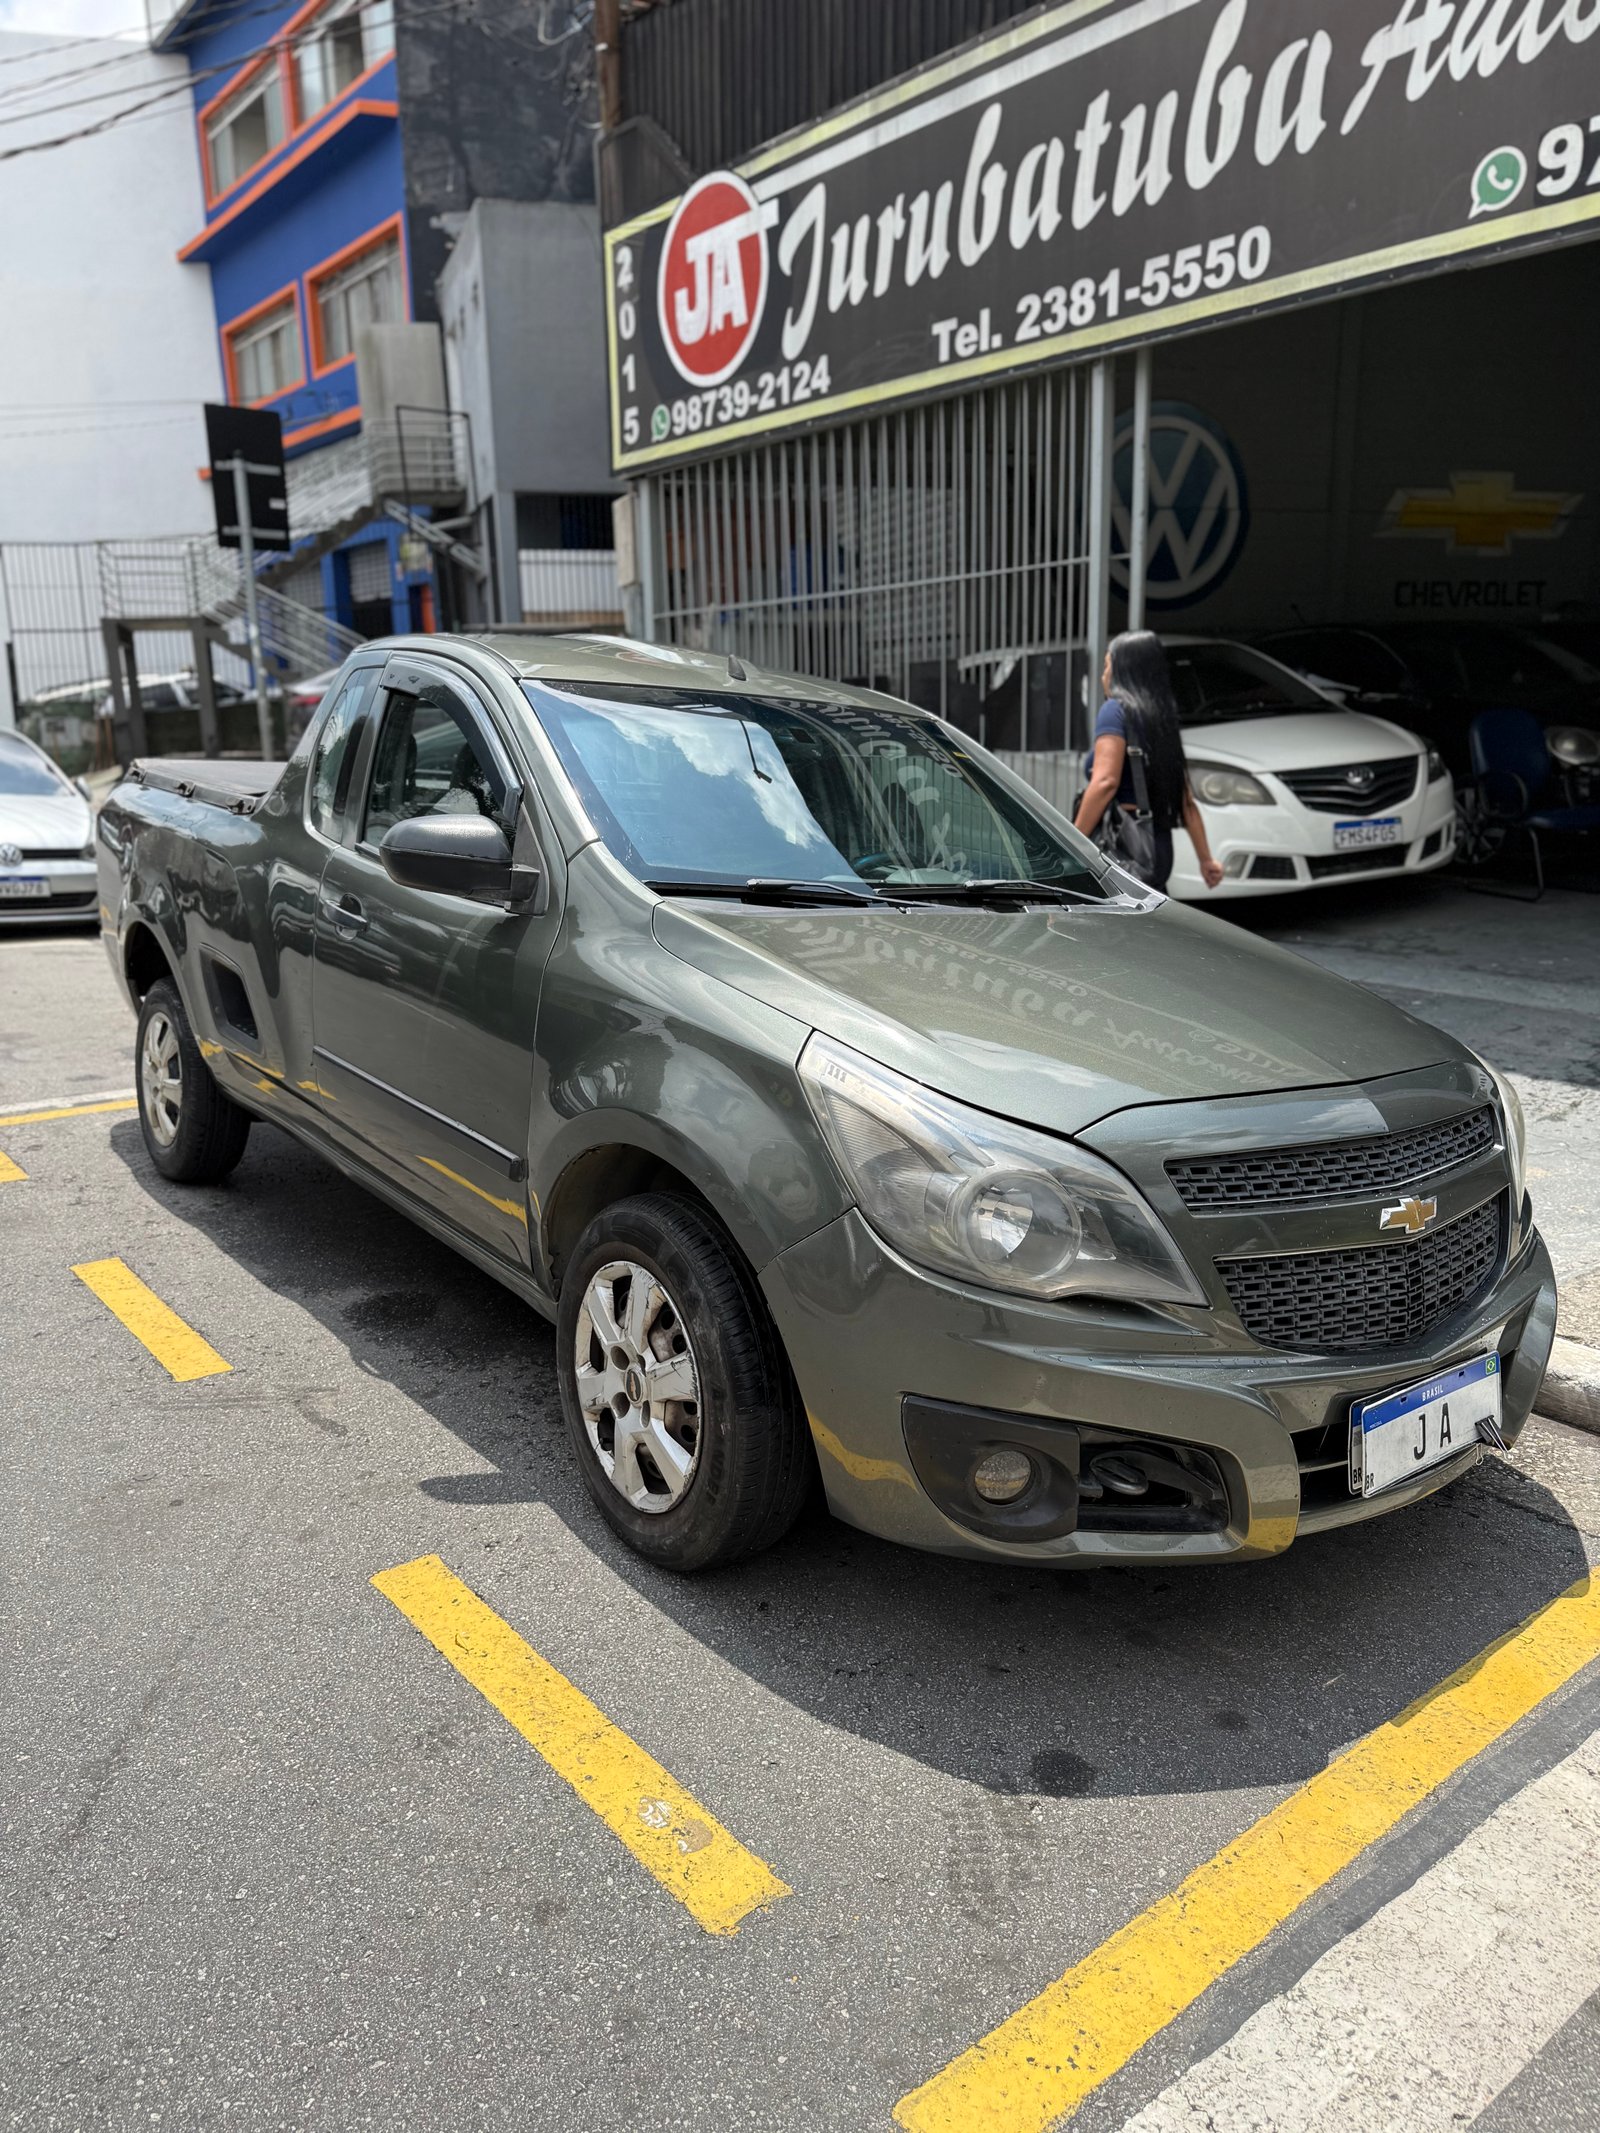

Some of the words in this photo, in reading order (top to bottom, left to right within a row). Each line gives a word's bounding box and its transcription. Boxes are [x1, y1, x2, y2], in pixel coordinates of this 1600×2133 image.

[778, 0, 1333, 361] Jurubatuba
[932, 308, 1002, 363] Tel.
[1014, 225, 1271, 342] 2381-5550
[671, 354, 831, 436] 98739-2124
[1394, 580, 1547, 608] CHEVROLET
[1421, 1384, 1444, 1402] BRASIL
[1413, 1413, 1426, 1461] J
[1439, 1402, 1452, 1448] A
